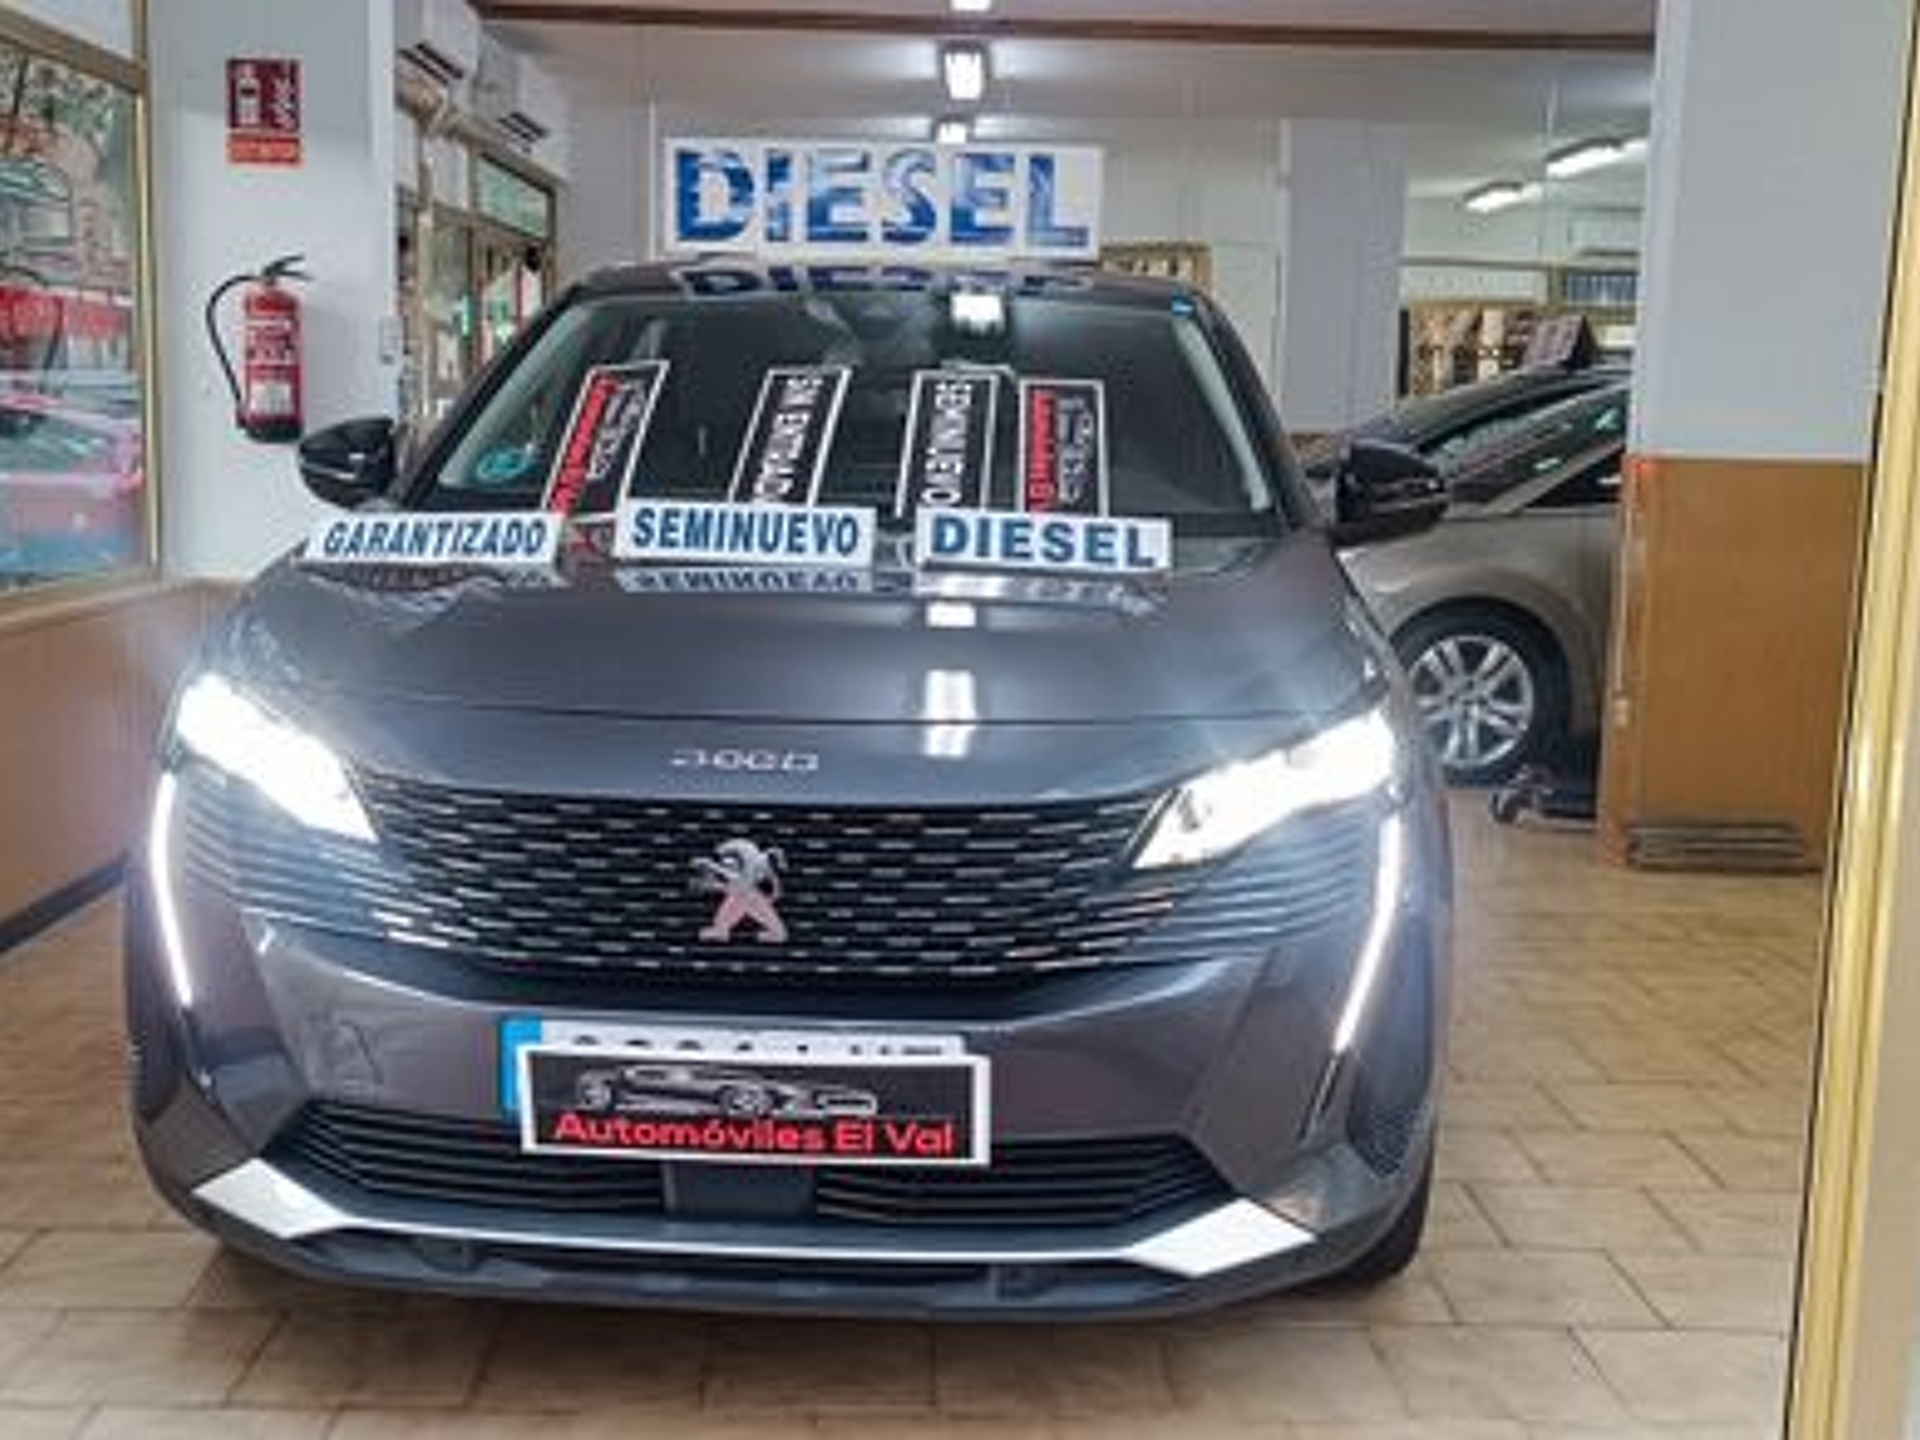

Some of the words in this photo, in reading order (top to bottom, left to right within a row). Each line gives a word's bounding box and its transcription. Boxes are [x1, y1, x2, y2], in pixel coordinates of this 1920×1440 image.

[676, 147, 1090, 248] DIESEL
[323, 519, 547, 557] GARANTIZADO
[633, 506, 859, 557] SEMINUEVO
[931, 515, 1156, 567] DIESEL
[555, 1112, 825, 1150] Automóviles
[836, 1121, 874, 1151] El
[885, 1121, 953, 1154] Val
